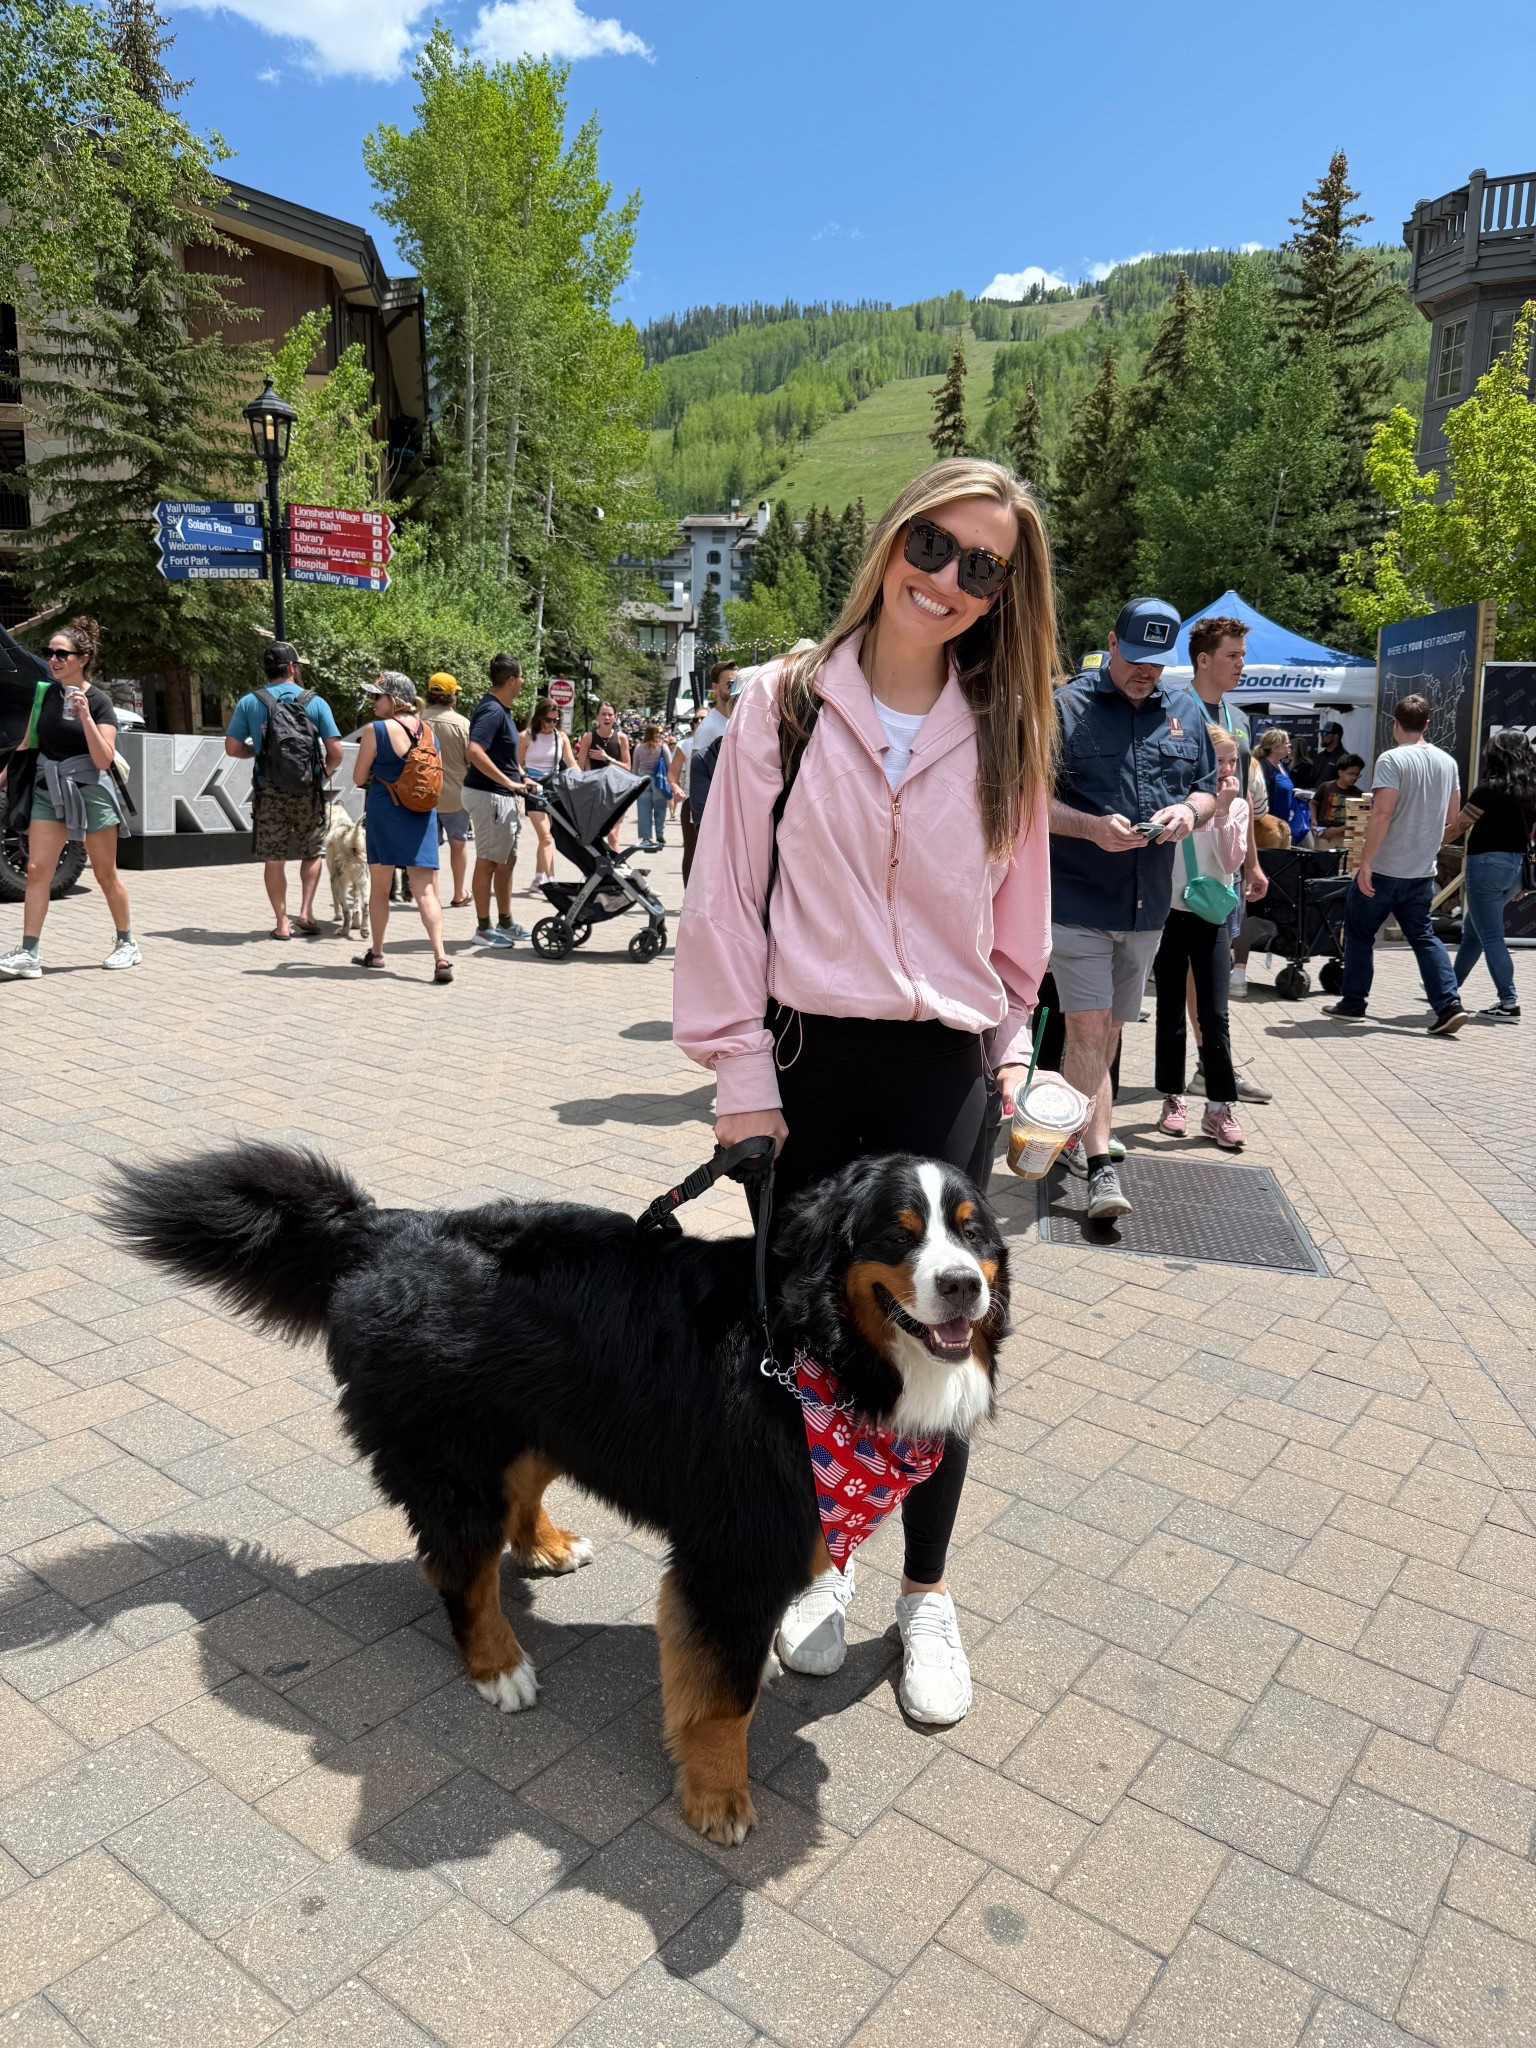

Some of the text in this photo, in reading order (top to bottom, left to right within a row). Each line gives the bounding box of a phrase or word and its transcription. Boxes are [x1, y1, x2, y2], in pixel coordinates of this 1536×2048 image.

[166, 503, 211, 515] Vail Village
[294, 506, 360, 523] Lionshead Village
[167, 515, 181, 525] Ski
[187, 518, 233, 535] Solaris Plaza
[294, 518, 342, 532] Eagle Bahn
[168, 541, 207, 551] Welcome
[294, 532, 324, 546] Library
[295, 544, 367, 560] Dobson Ice Arena
[169, 555, 210, 566] Ford Park
[295, 558, 329, 571] Hospital
[295, 569, 359, 586] Gore Valley Trail
[1238, 673, 1325, 689] Goodrich
